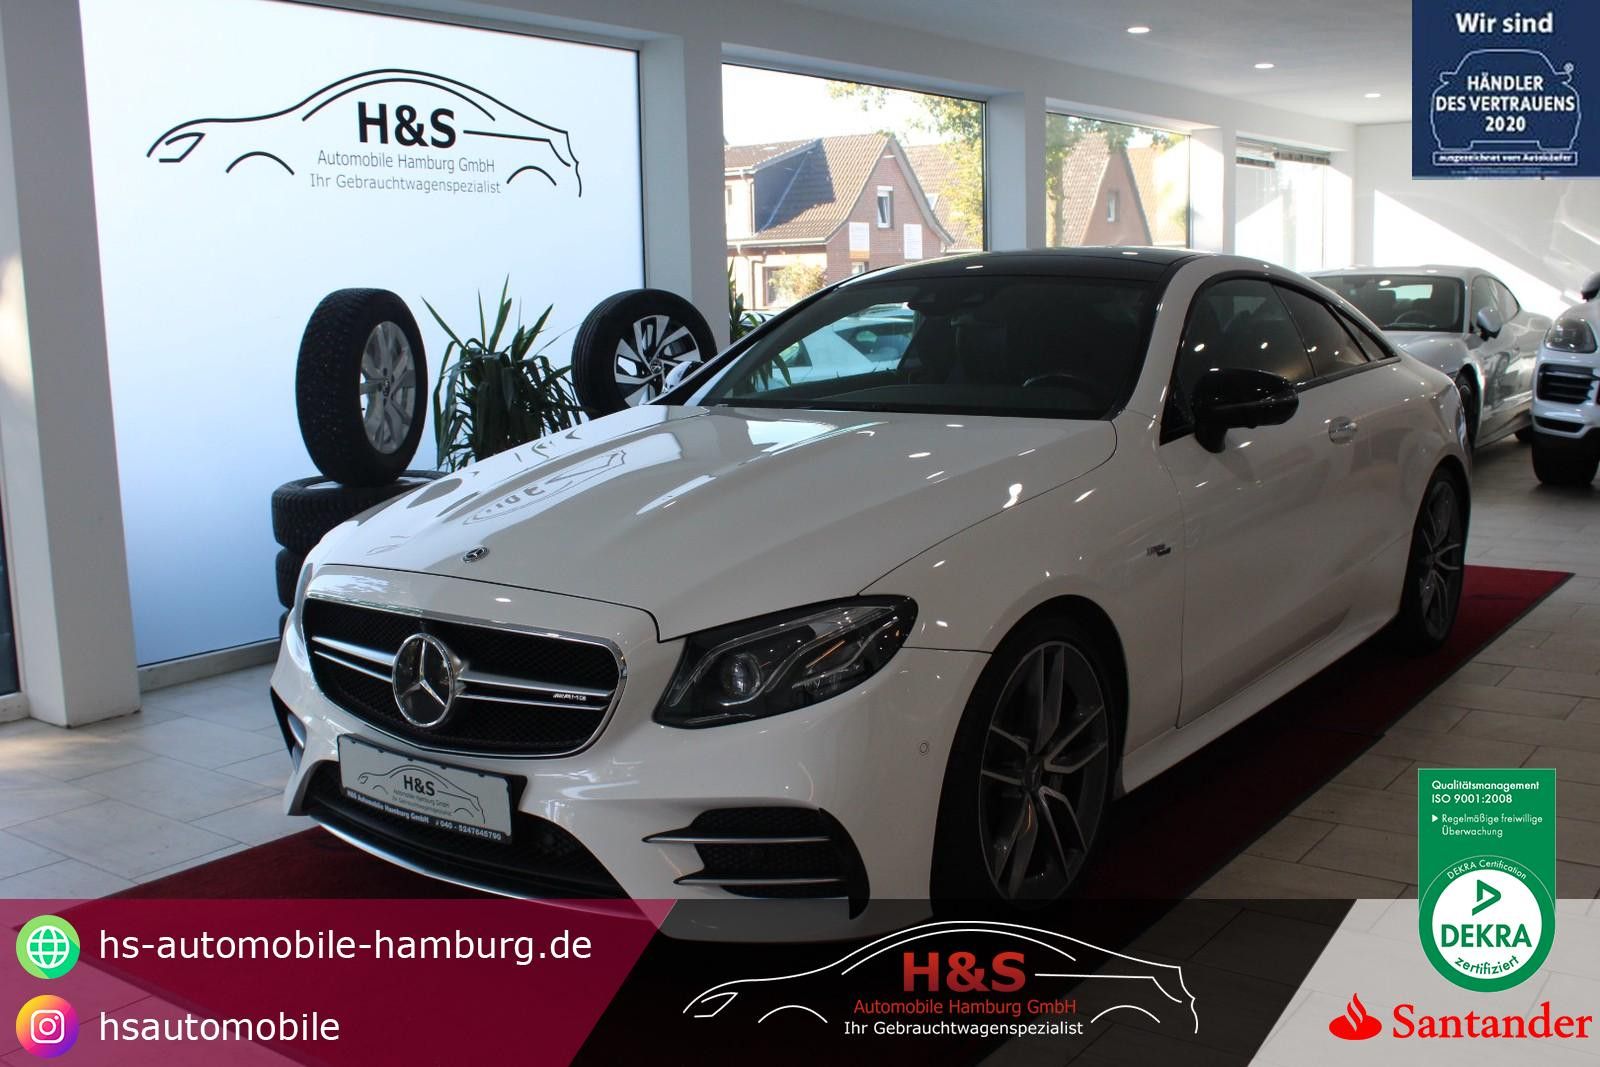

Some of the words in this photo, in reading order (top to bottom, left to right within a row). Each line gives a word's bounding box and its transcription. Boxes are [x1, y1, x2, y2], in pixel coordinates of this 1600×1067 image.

[357, 101, 456, 149] H&S
[317, 150, 394, 168] Automobile
[397, 154, 455, 174] Hamburg
[458, 157, 495, 173] GmbH
[310, 173, 332, 188] Ihr
[336, 174, 502, 195] Gebrauchtwagenspezialist
[403, 774, 436, 797] H&S
